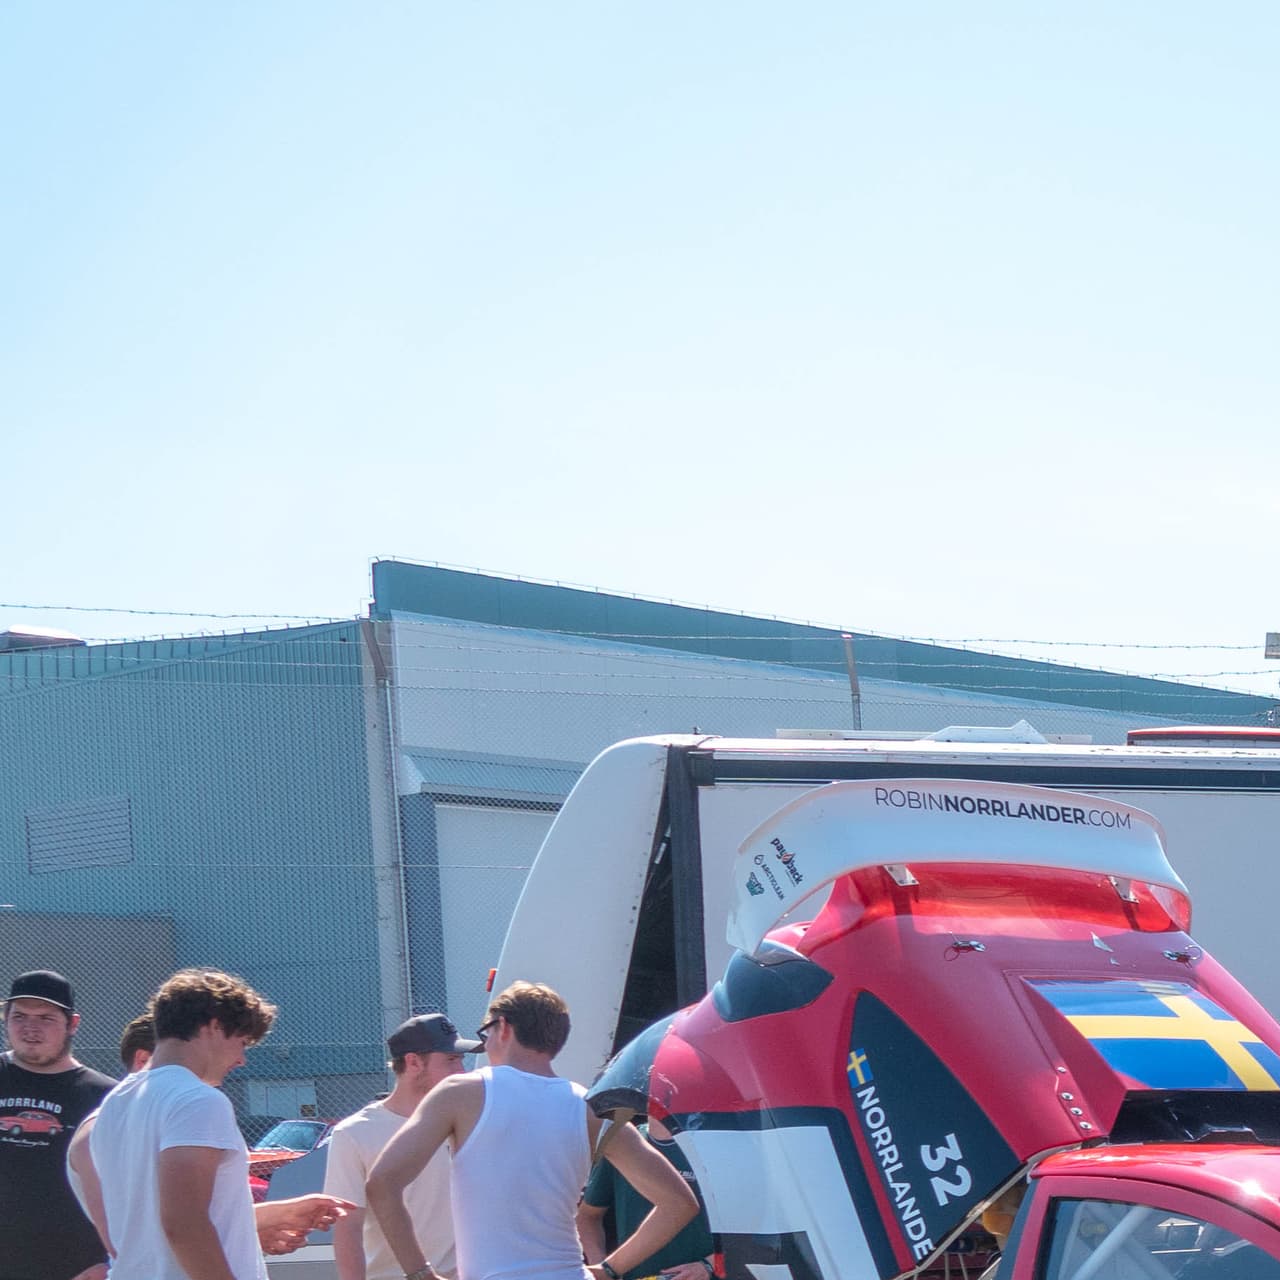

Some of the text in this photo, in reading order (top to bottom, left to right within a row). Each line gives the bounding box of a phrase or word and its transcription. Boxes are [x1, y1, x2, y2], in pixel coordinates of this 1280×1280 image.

[875, 787, 1131, 829] ROBINNORRLANDER.COM
[0, 1097, 62, 1114] NORRLAND
[920, 1133, 972, 1206] 32
